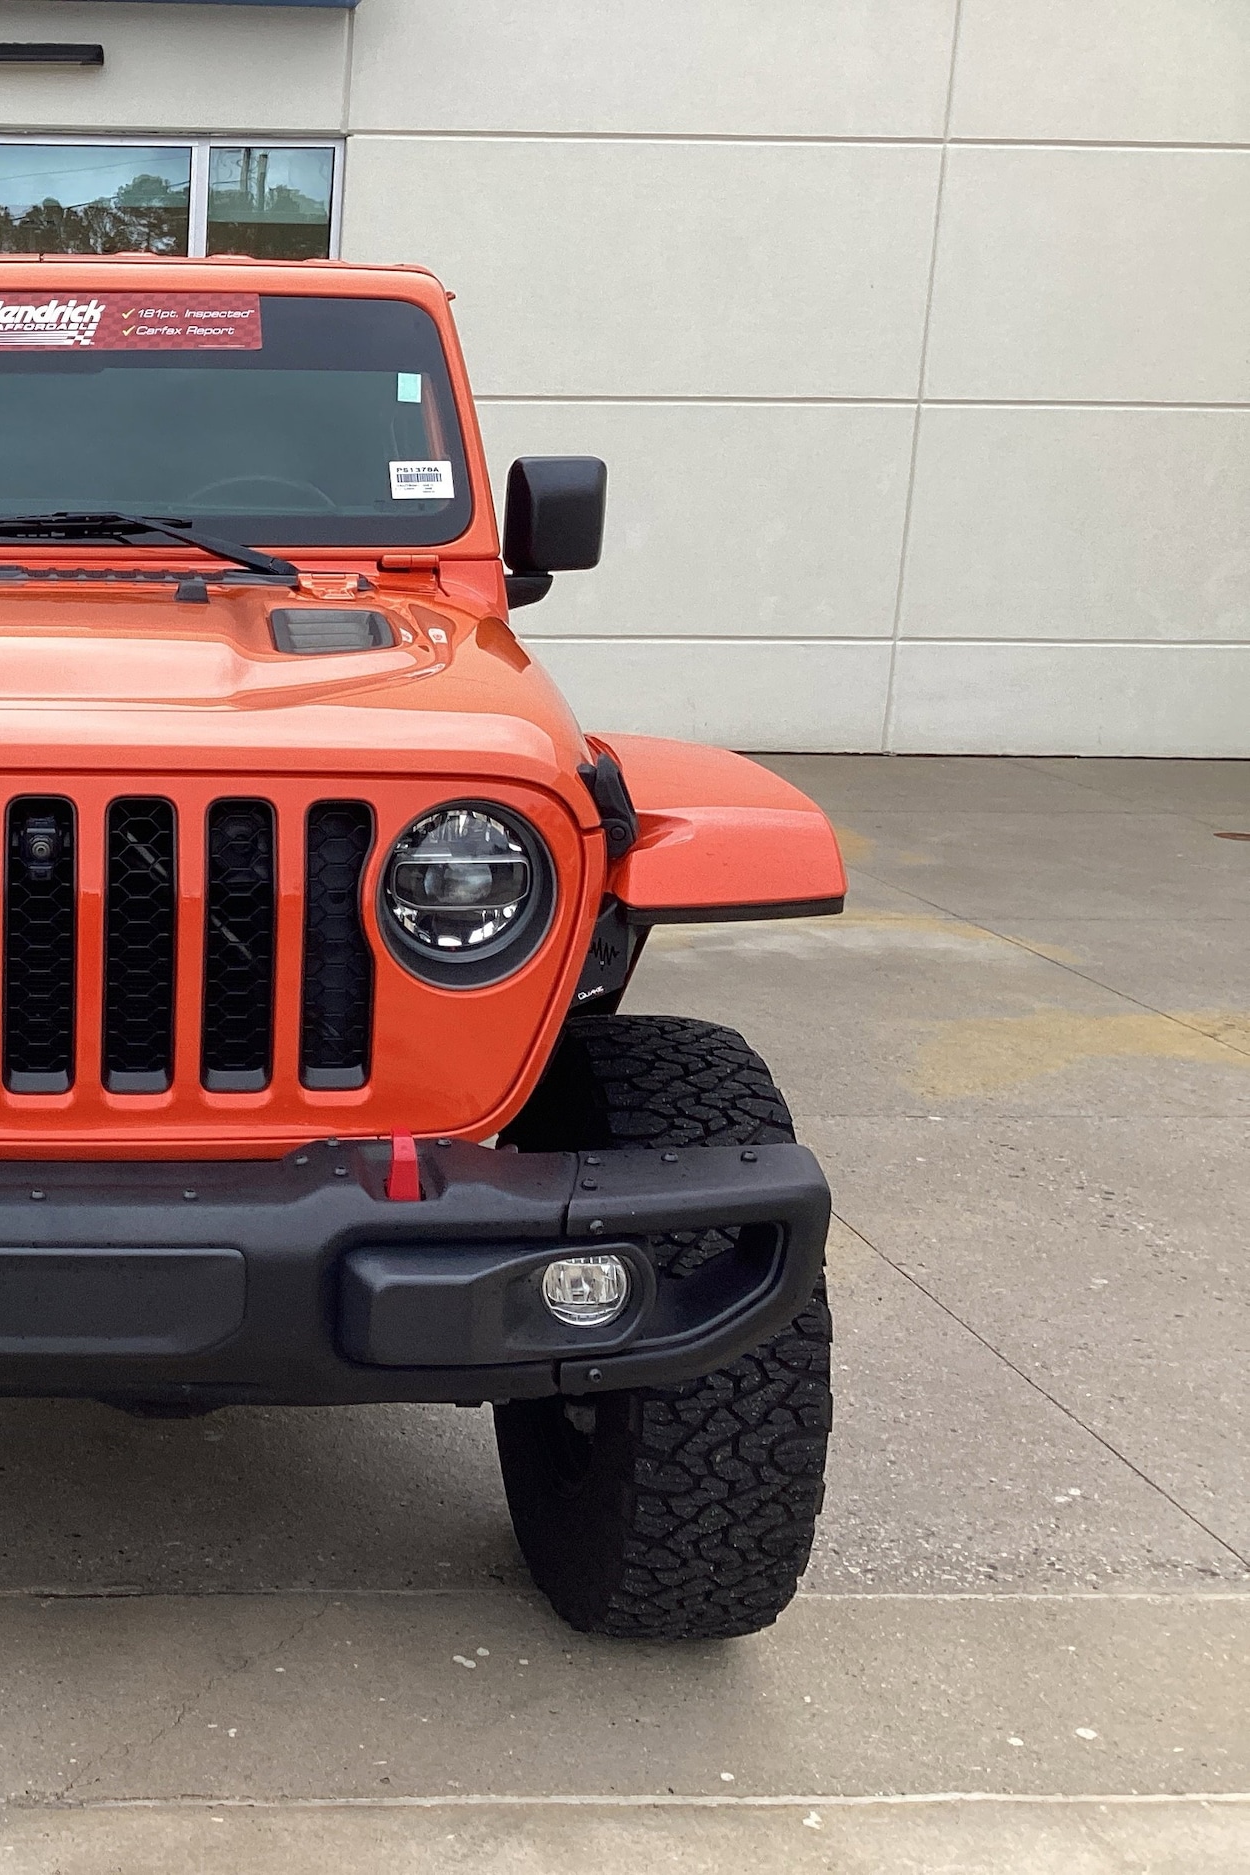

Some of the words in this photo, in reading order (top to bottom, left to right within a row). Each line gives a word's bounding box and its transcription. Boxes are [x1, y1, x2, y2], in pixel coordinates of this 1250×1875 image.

[138, 309, 179, 319] 181pt.
[136, 326, 182, 335] Carfax
[185, 326, 235, 336] Report
